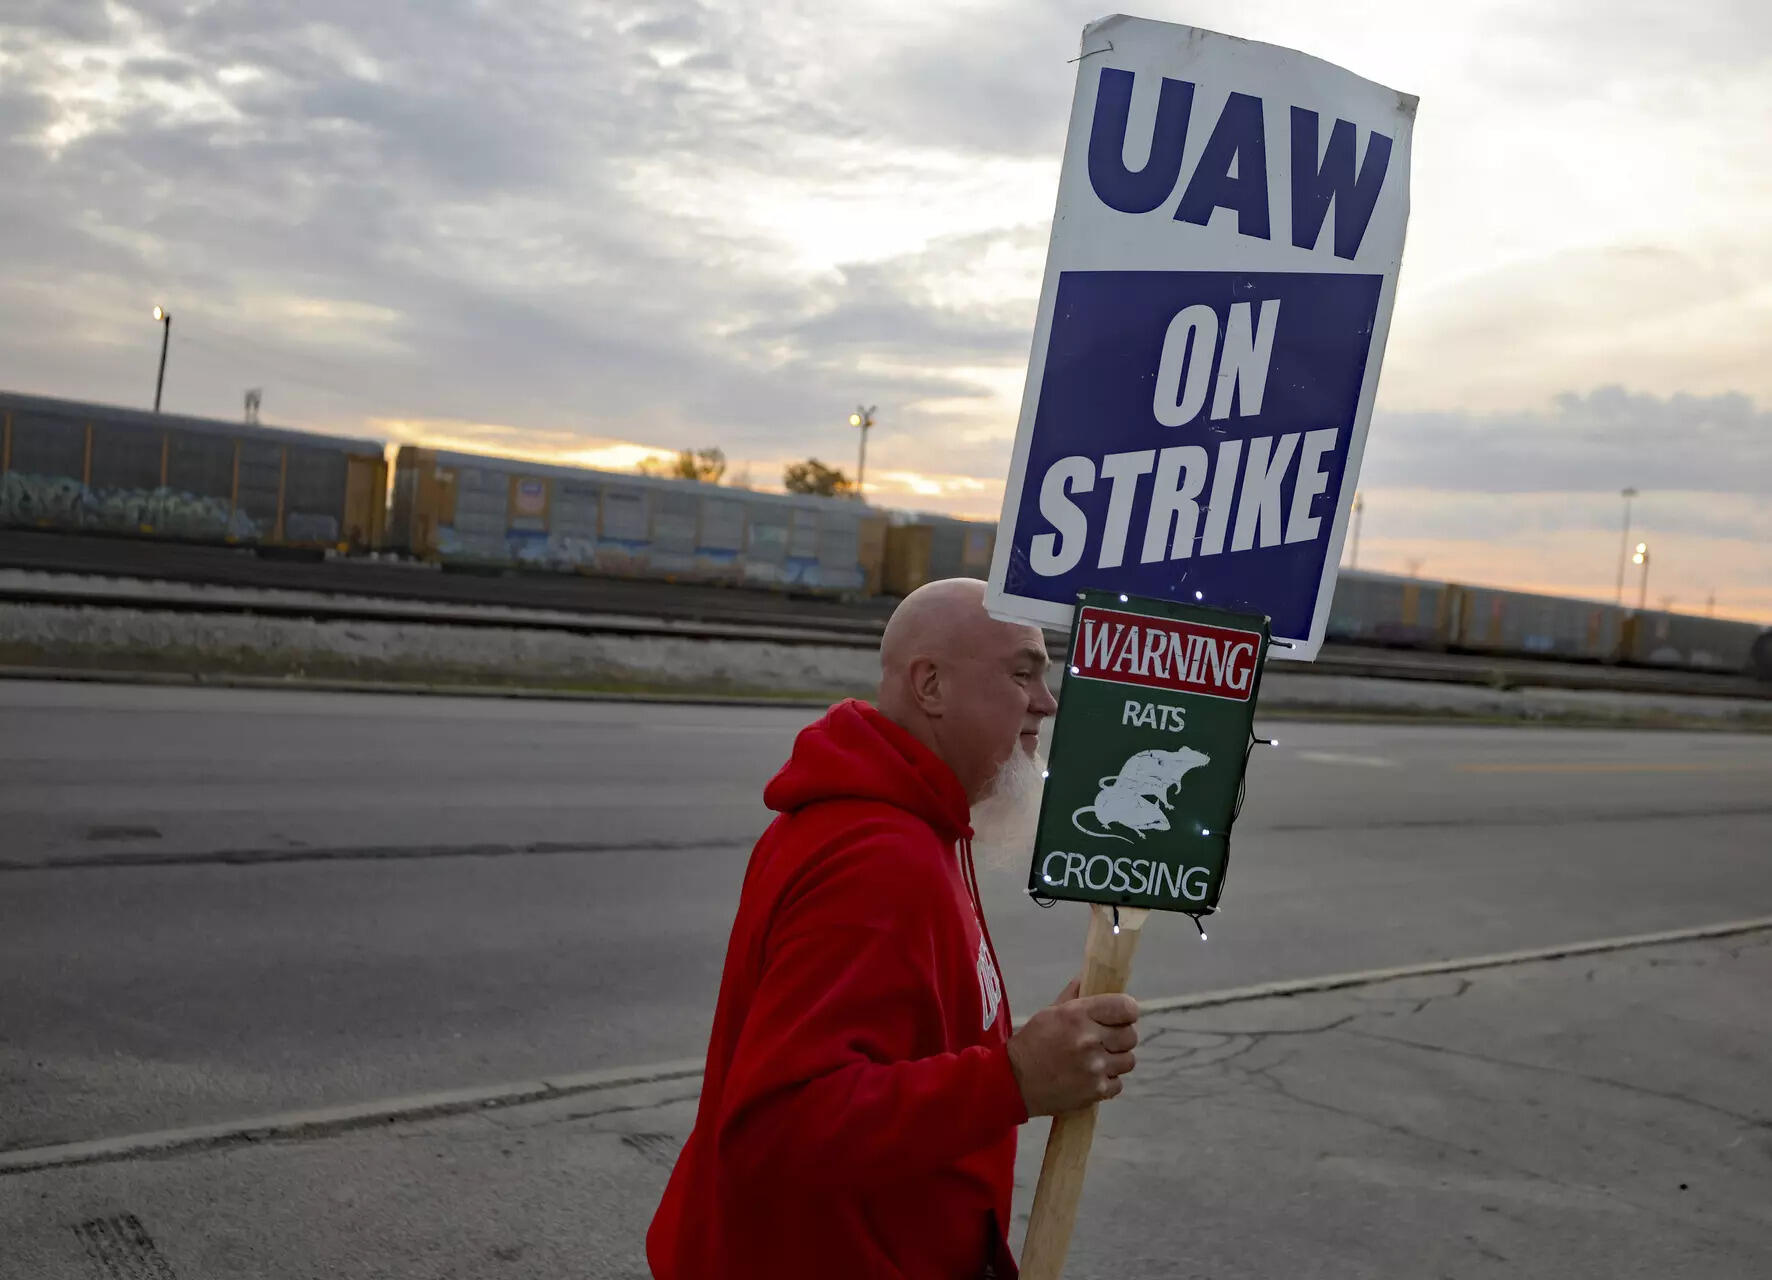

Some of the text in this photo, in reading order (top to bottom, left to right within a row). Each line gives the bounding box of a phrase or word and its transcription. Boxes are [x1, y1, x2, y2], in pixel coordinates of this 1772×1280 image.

[1088, 67, 1393, 260] UAW
[1153, 299, 1281, 427] ON
[1029, 427, 1339, 577] STRIKE
[1081, 620, 1254, 690] WARNING
[1122, 700, 1186, 732] RATS
[1042, 851, 1210, 901] CROSSING
